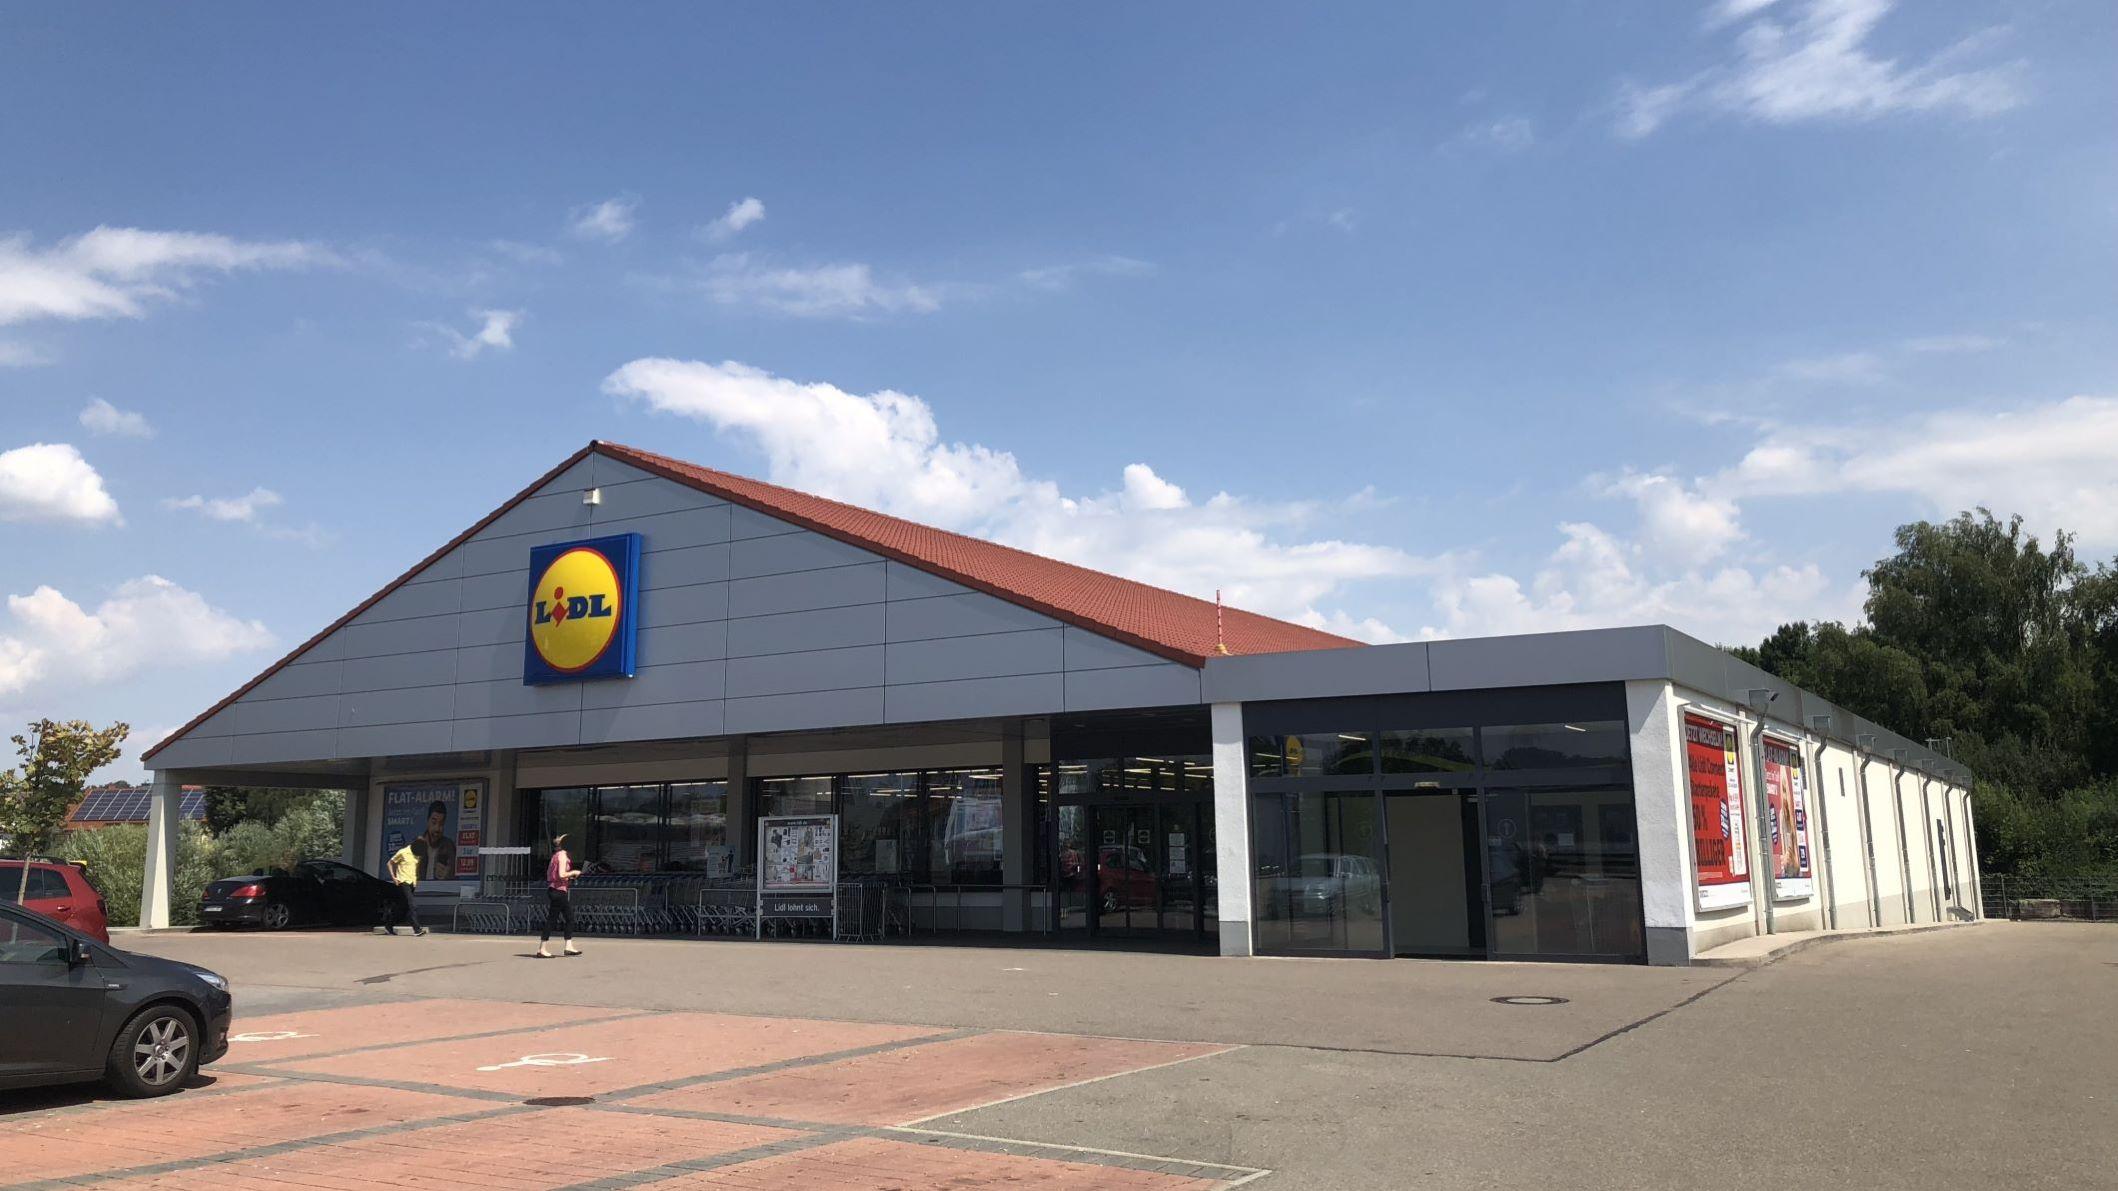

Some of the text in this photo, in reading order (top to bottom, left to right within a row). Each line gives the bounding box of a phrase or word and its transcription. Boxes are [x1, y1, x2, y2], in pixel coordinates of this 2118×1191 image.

[388, 789, 456, 804] FLAT-ALARM!
[774, 903, 820, 912] Lidl lohnt sich.
